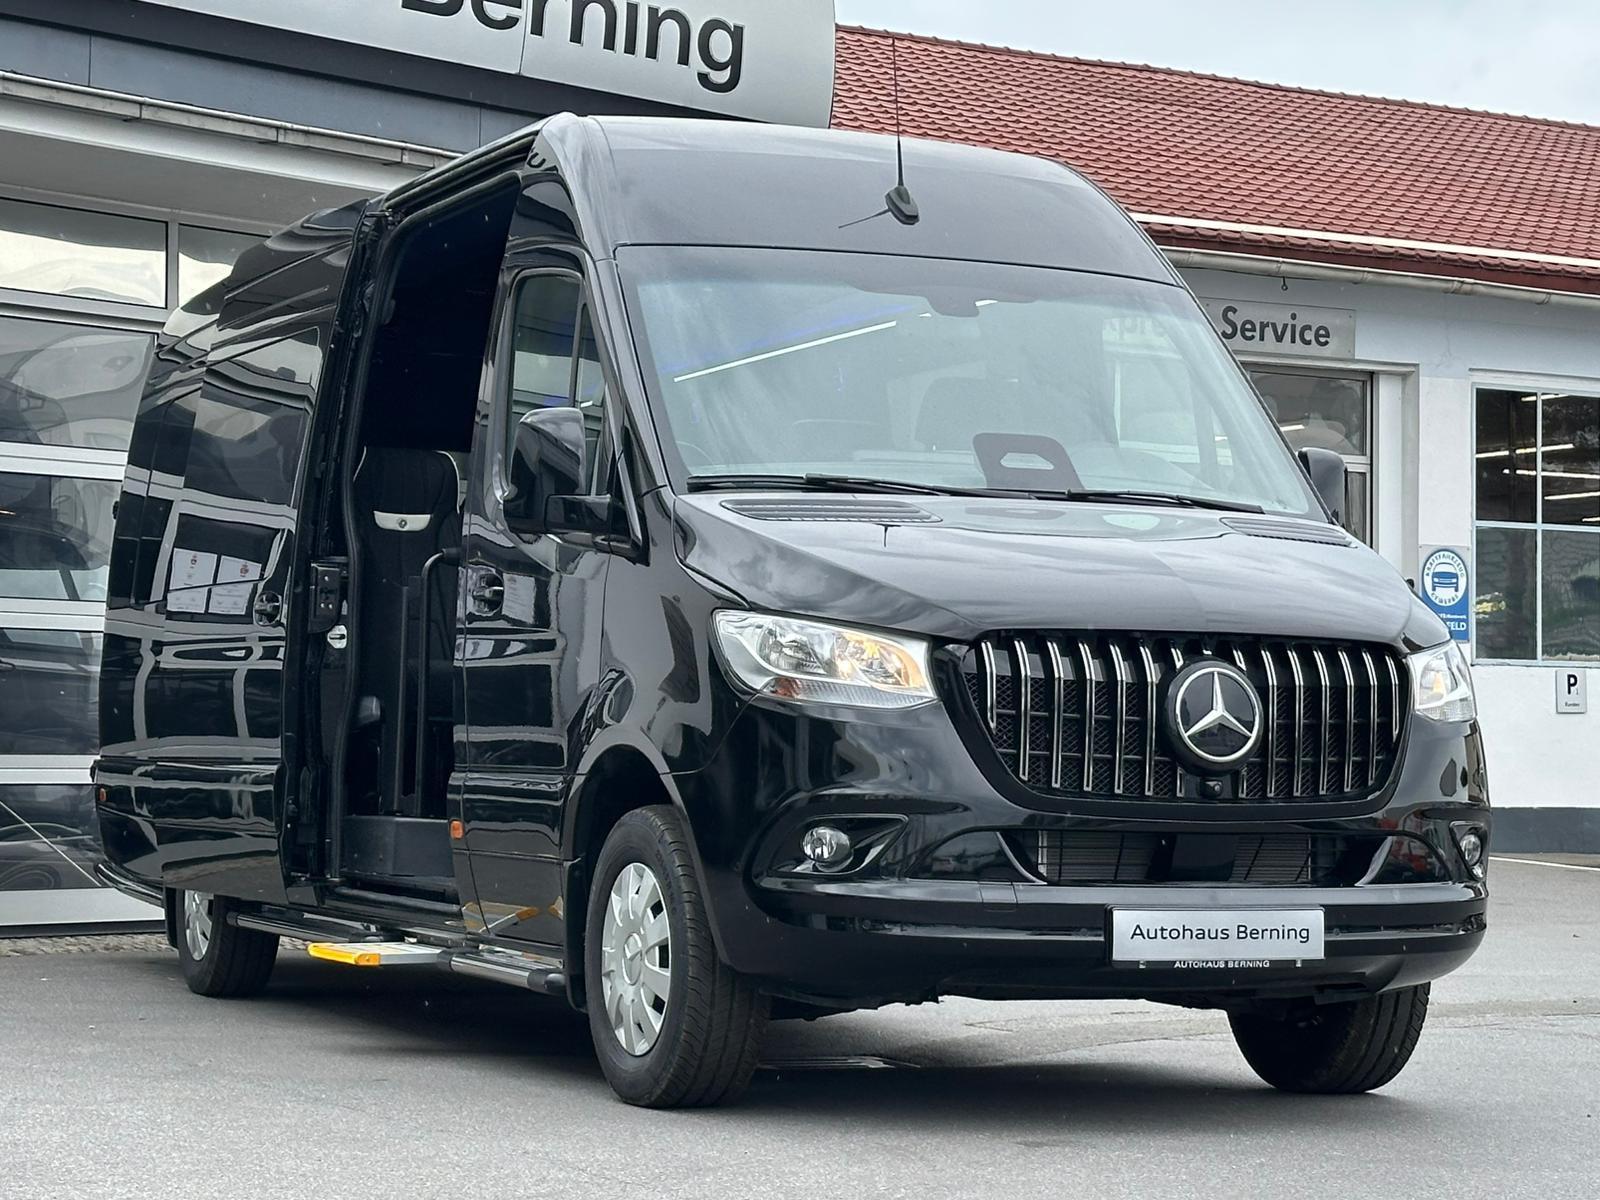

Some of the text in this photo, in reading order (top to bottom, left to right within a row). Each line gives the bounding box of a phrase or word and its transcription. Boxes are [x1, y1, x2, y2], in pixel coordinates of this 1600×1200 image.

[401, 0, 744, 93] erning
[1221, 305, 1330, 347] Service
[1567, 673, 1578, 695] P
[1130, 924, 1310, 943] Autohaus Berning
[1174, 960, 1270, 968] AUTOHAUS BERNING
